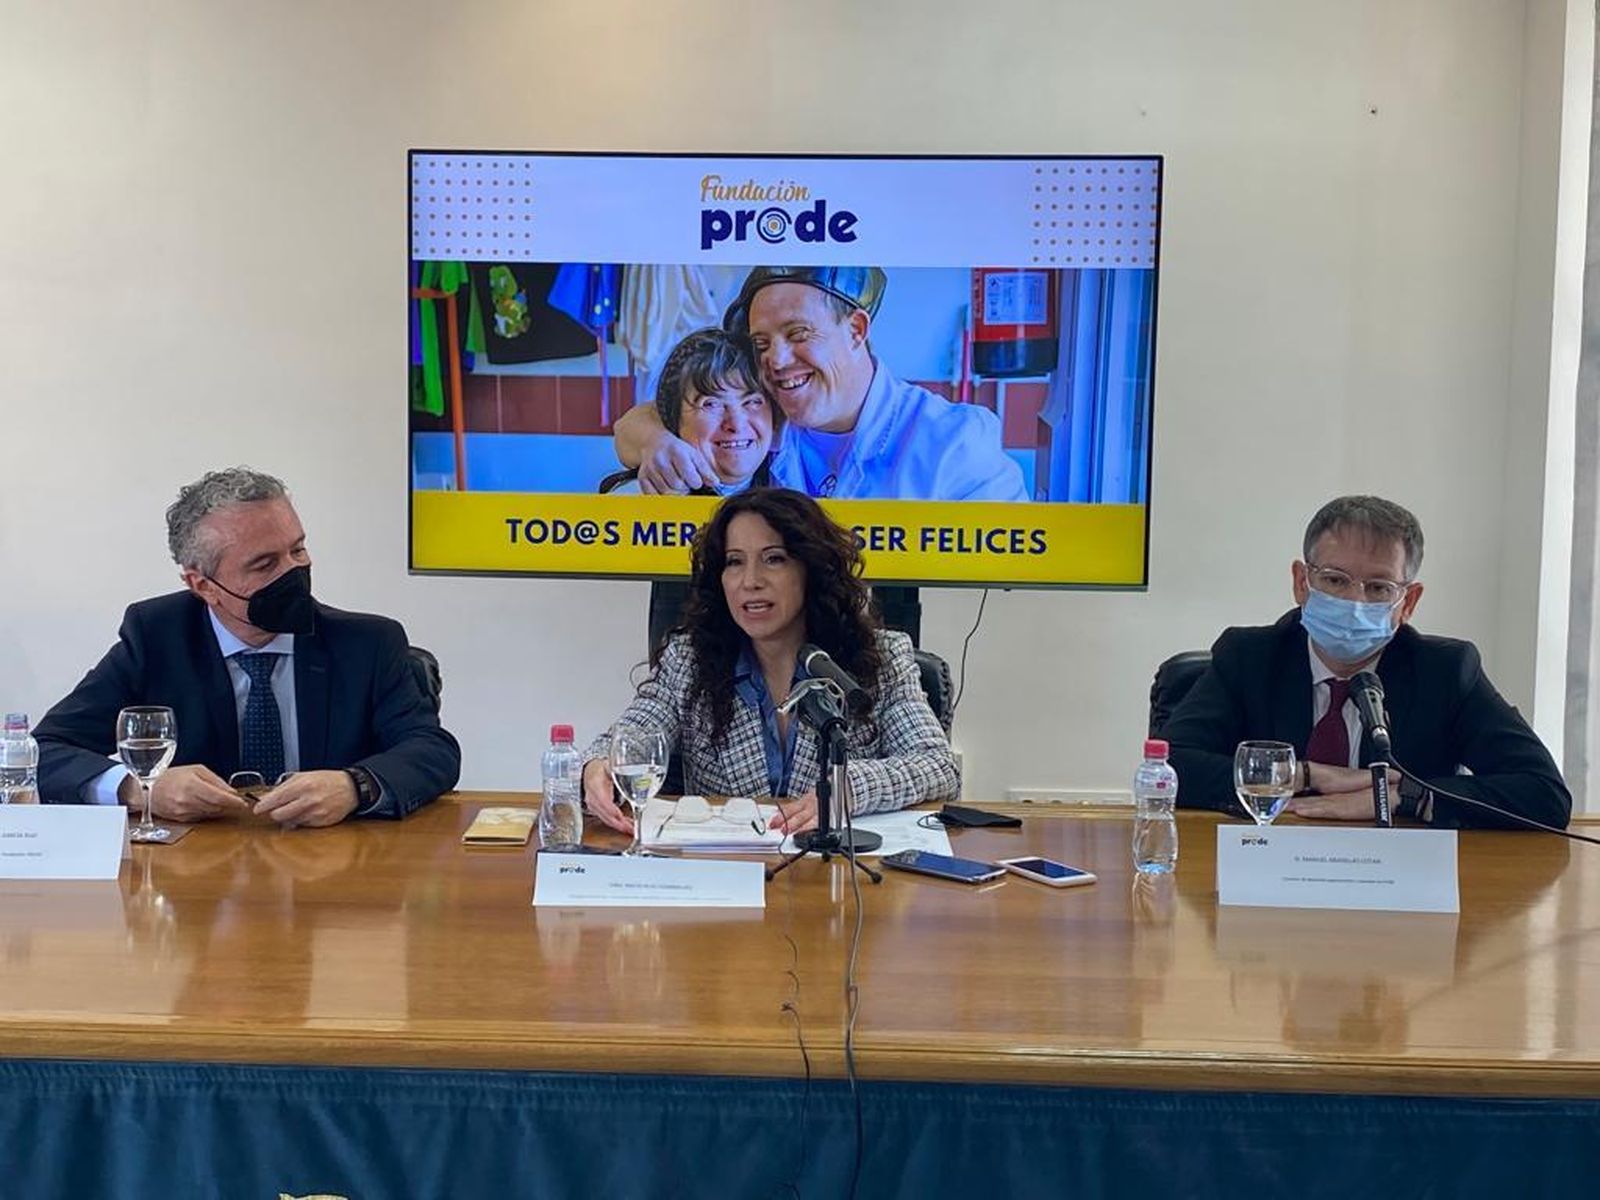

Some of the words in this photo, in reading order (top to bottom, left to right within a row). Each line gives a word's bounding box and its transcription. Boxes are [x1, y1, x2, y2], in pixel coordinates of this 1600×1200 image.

[701, 174, 811, 202] Fundación
[505, 518, 620, 546] TOD@S
[632, 520, 698, 547] MER
[850, 525, 907, 552] SER
[920, 527, 1047, 555] FELICES
